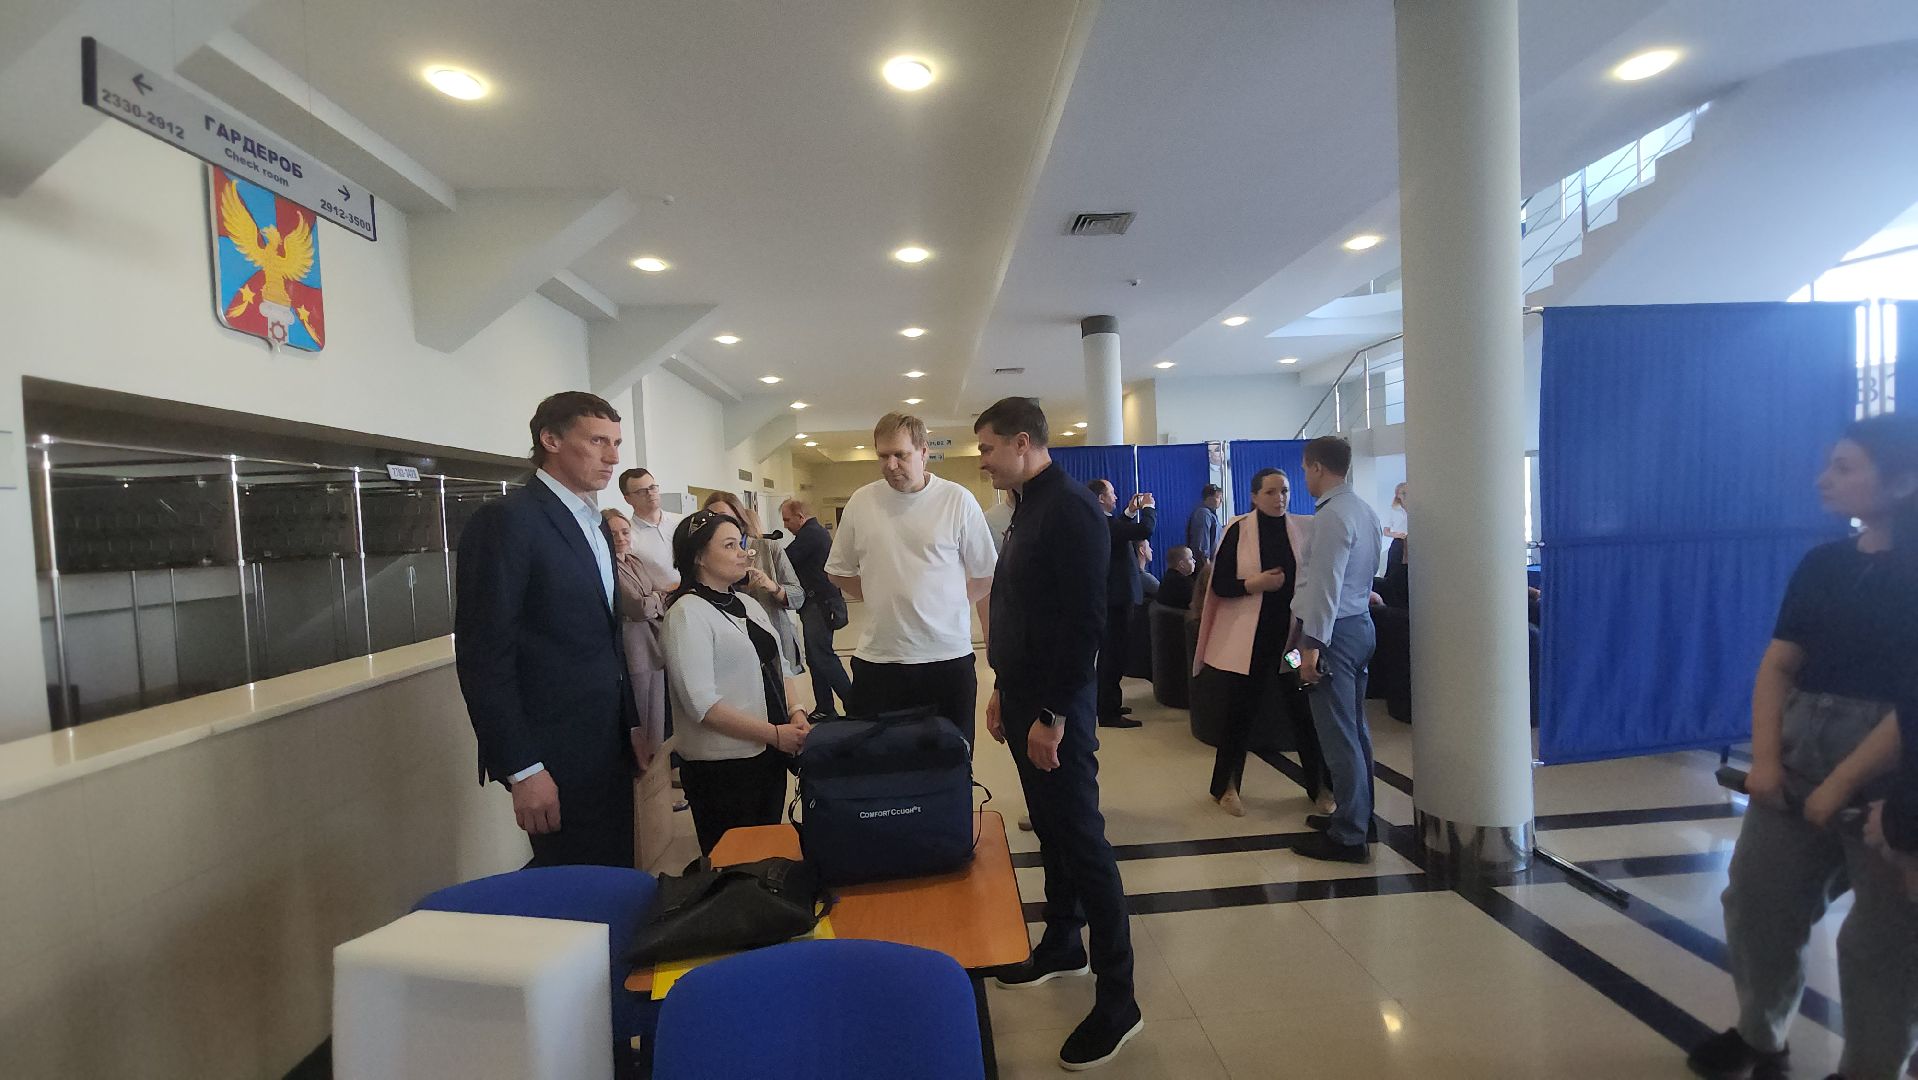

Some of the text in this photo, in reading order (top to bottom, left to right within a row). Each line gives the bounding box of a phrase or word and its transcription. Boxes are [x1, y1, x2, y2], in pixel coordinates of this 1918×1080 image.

[102, 88, 184, 140] 2330-2912
[204, 114, 303, 179] ГАРДЕРОБ
[224, 147, 290, 188] Check room
[320, 198, 372, 232] 2912-3500
